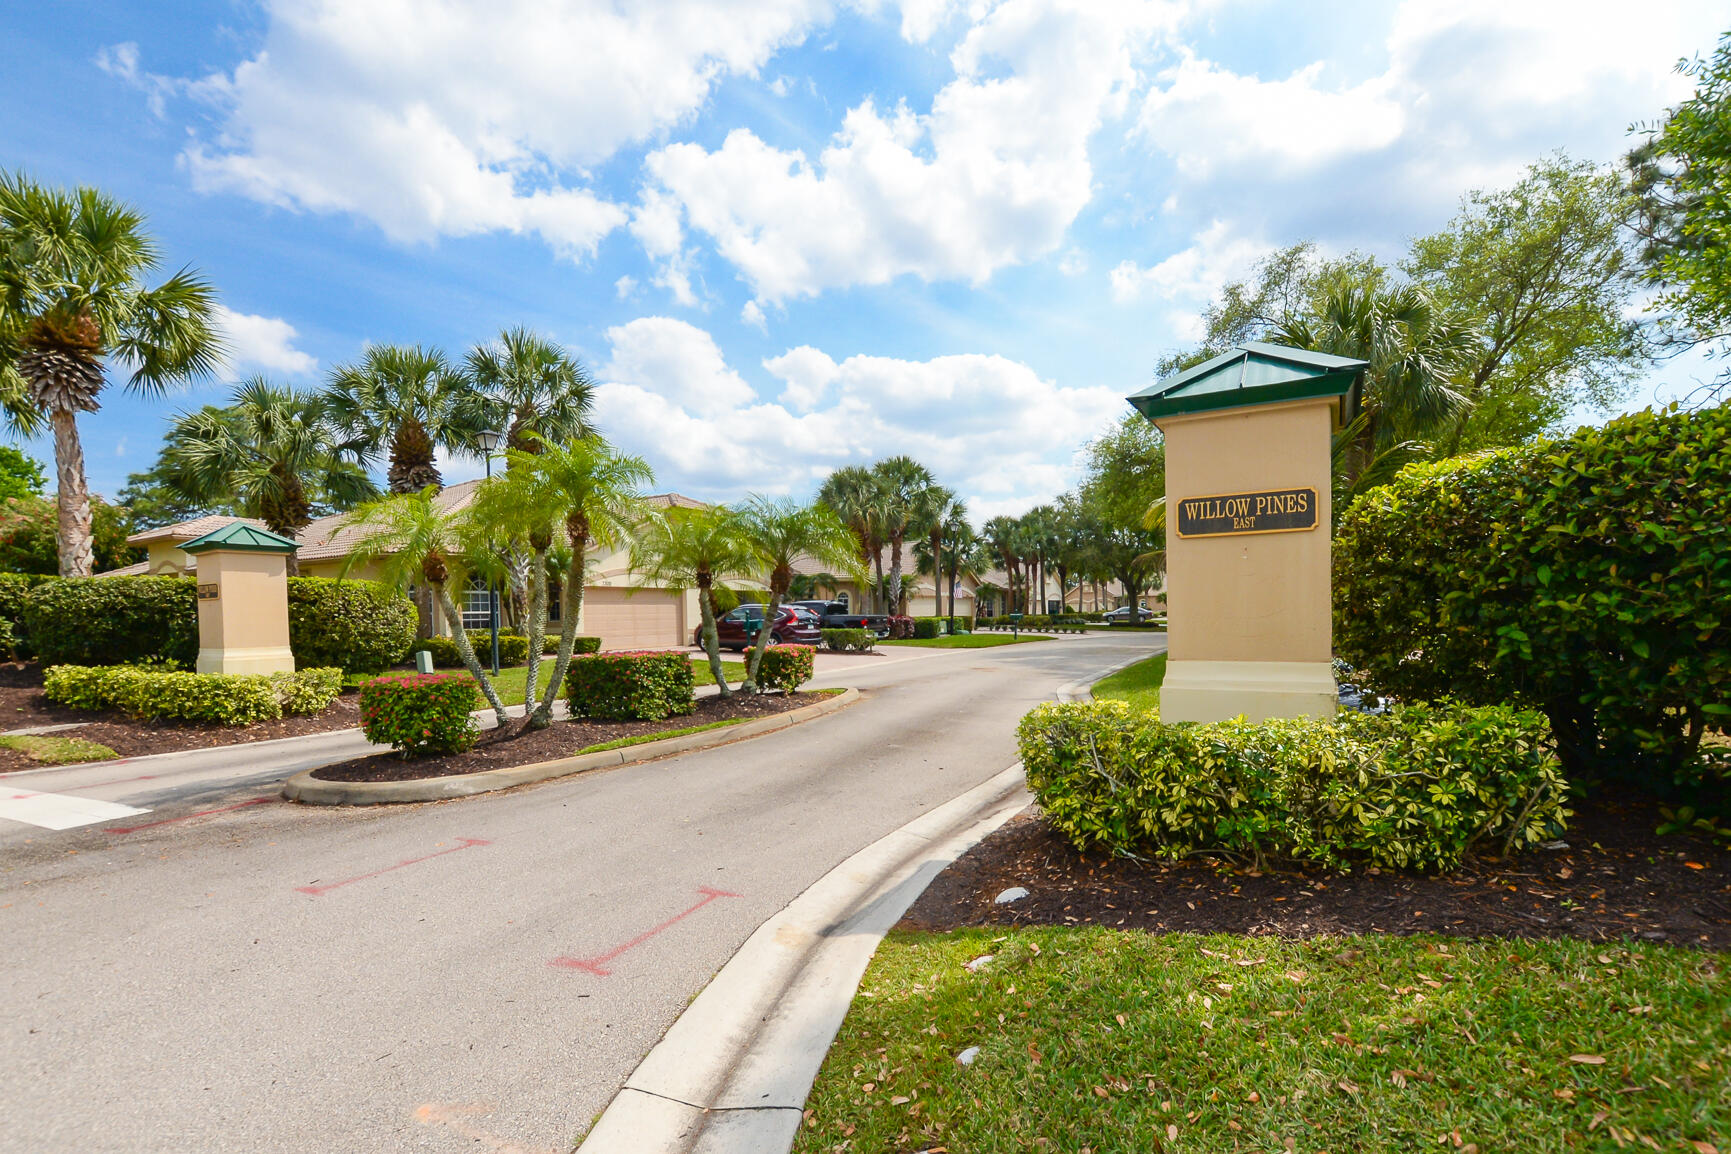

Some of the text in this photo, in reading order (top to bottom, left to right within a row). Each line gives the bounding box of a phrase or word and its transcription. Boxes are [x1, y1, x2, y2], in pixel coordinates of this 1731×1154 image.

[1185, 493, 1308, 520] WILLOW PINES
[1233, 517, 1256, 529] EAST
